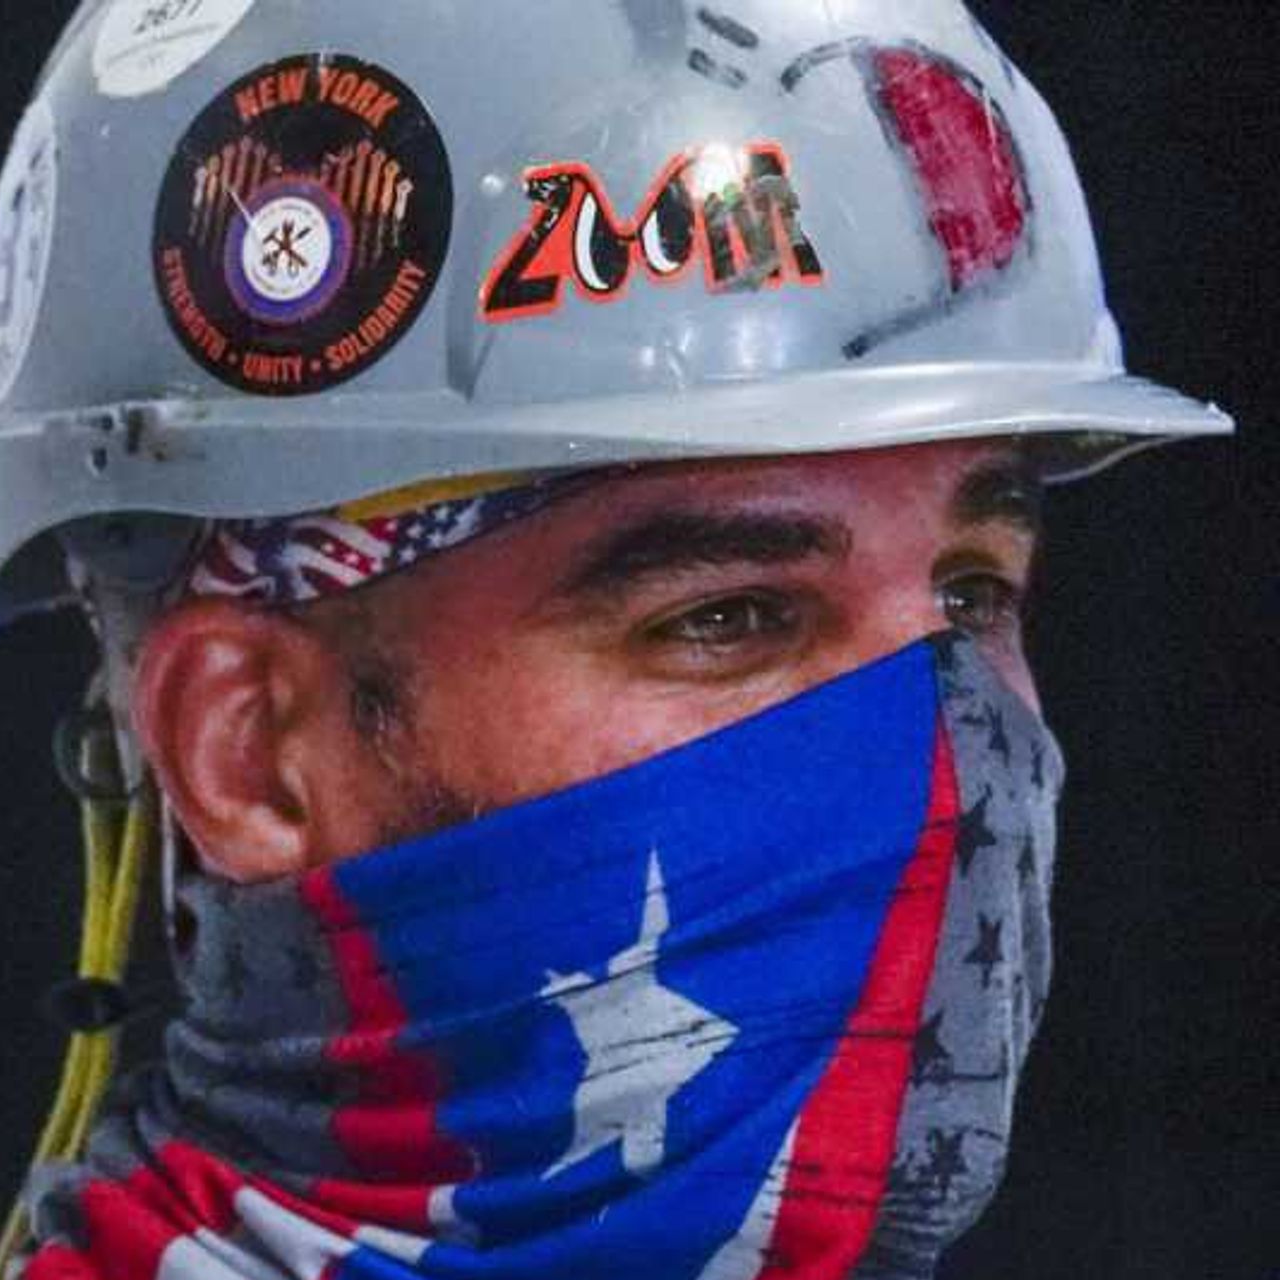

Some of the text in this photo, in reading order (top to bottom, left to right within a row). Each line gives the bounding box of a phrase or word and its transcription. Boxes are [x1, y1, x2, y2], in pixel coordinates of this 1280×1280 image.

[234, 65, 399, 128] NEW YORK
[242, 353, 303, 384] UNITY
[325, 258, 427, 371] SOLIDARITY
